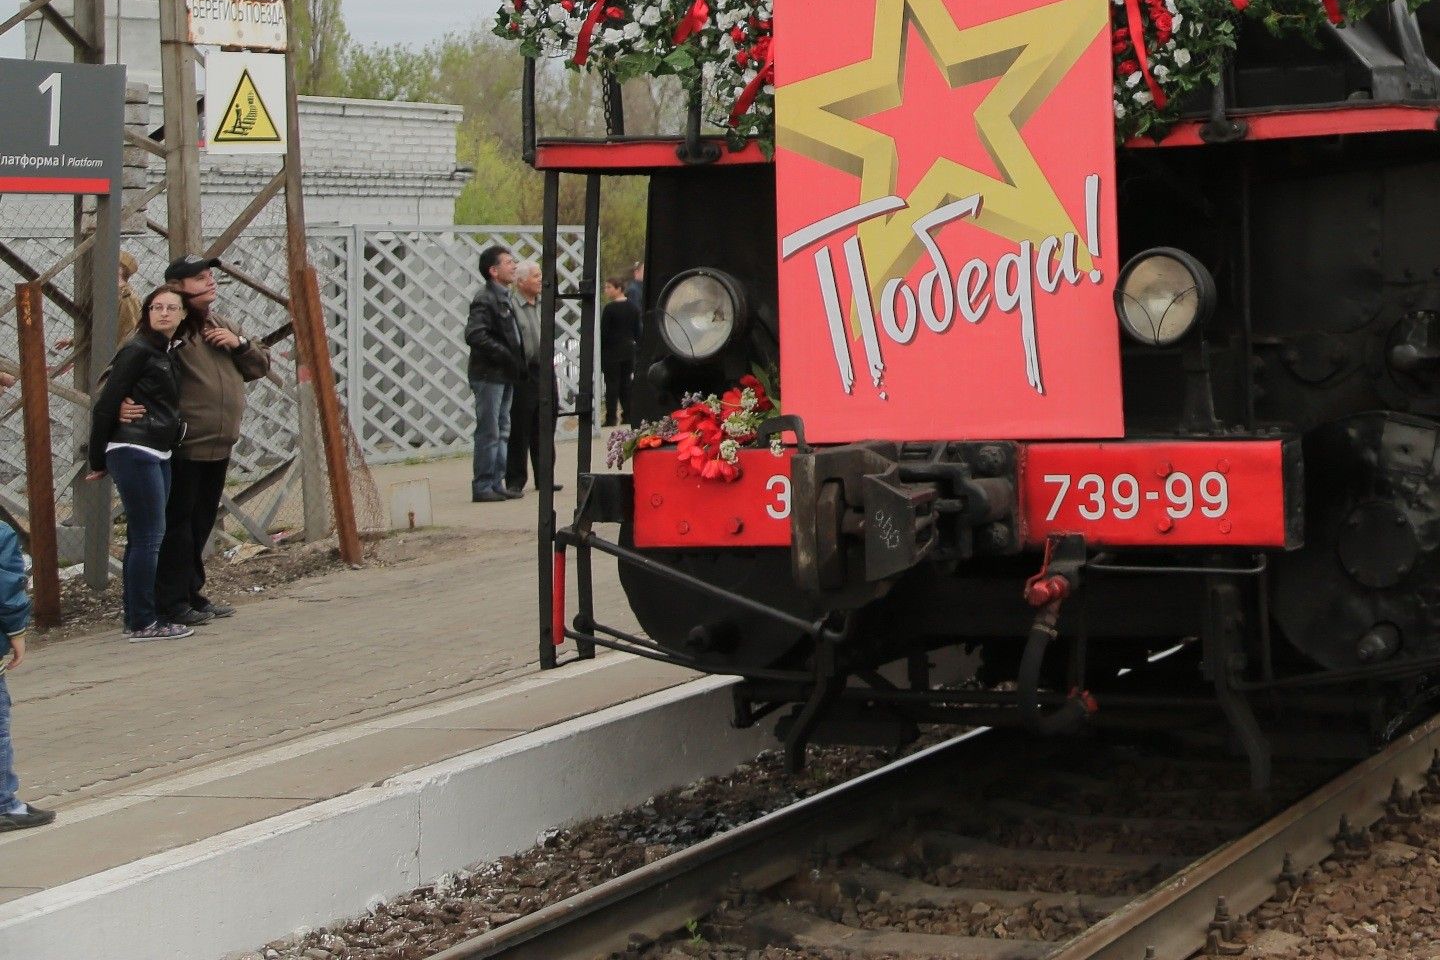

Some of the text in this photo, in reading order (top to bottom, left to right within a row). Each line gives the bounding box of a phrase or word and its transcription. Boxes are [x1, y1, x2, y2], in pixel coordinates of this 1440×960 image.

[245, 1, 285, 25] ПОЕЗДА
[38, 72, 62, 146] 1
[66, 156, 104, 168] Platform
[782, 173, 1102, 401] Победа!
[1043, 471, 1229, 521] 739-99
